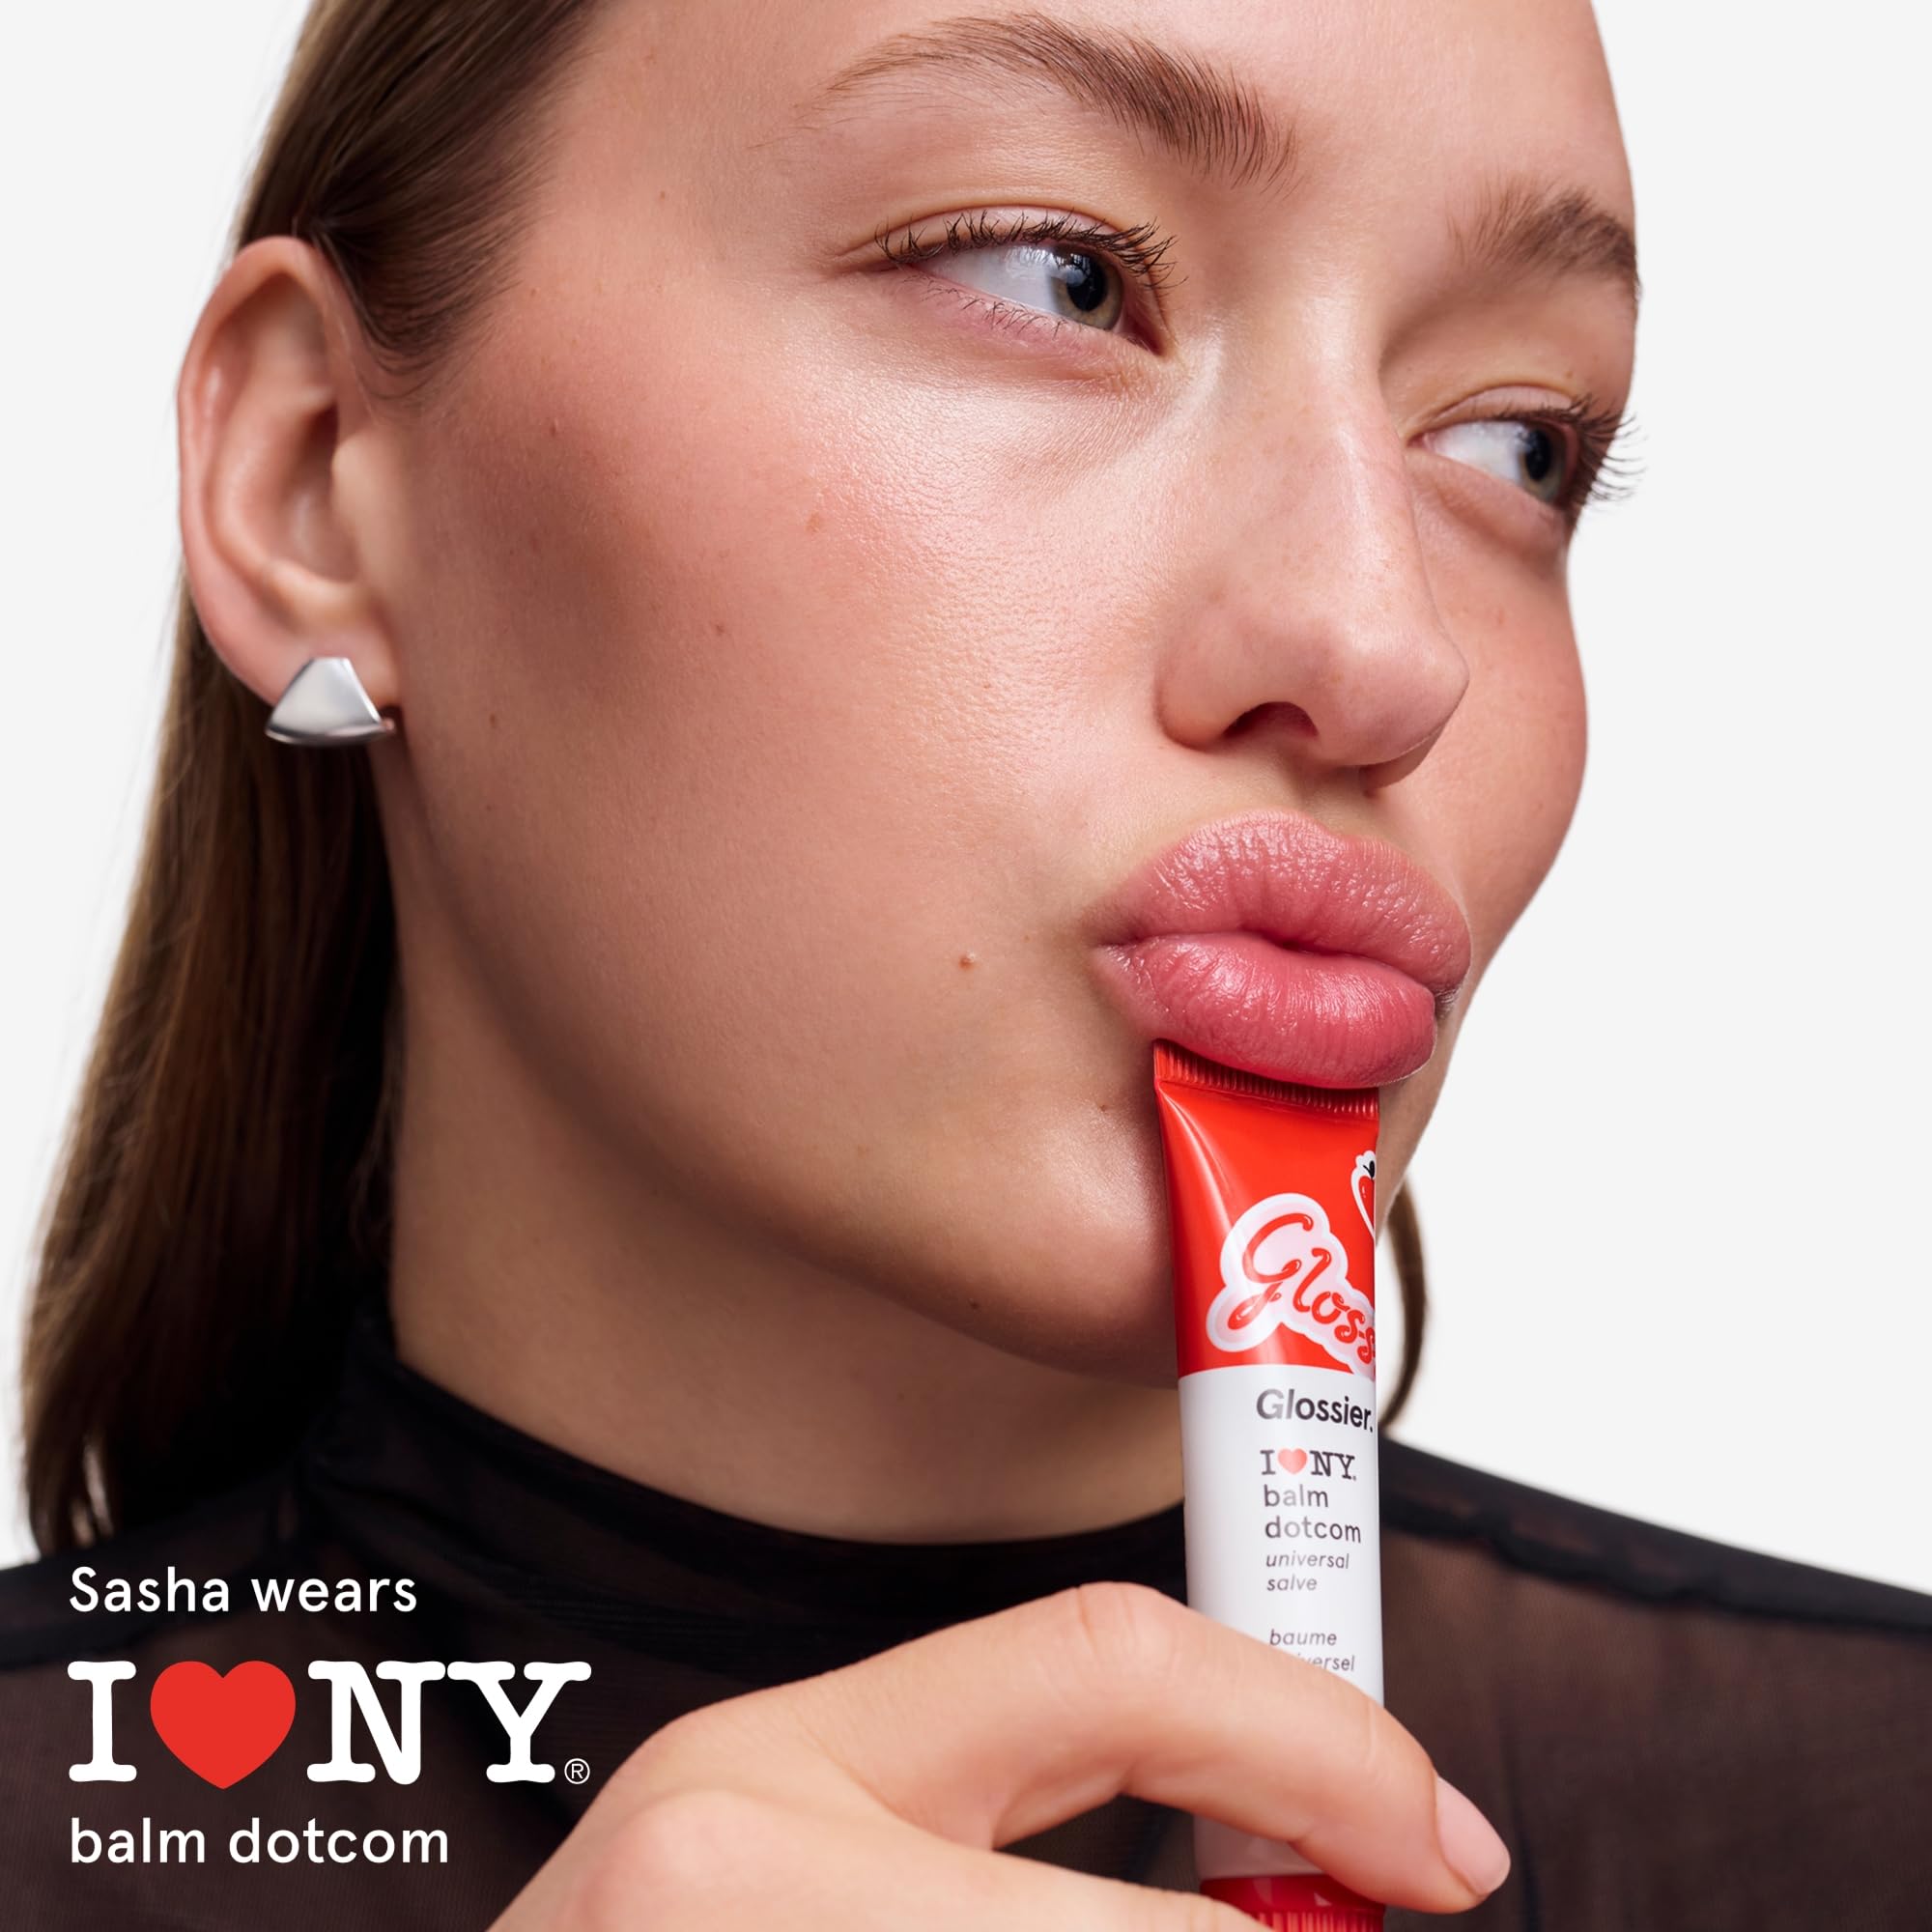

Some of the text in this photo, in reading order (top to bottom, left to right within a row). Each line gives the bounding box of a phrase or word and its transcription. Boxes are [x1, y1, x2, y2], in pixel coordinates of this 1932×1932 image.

[1228, 1212, 1376, 1365] Gloss
[1256, 1388, 1374, 1433] Glossier.
[1260, 1450, 1276, 1475] I
[1264, 1484, 1329, 1508] balm
[1264, 1515, 1361, 1544] dotcom
[1265, 1549, 1350, 1570] universal
[1266, 1574, 1318, 1592] salve
[1269, 1629, 1338, 1646] baume
